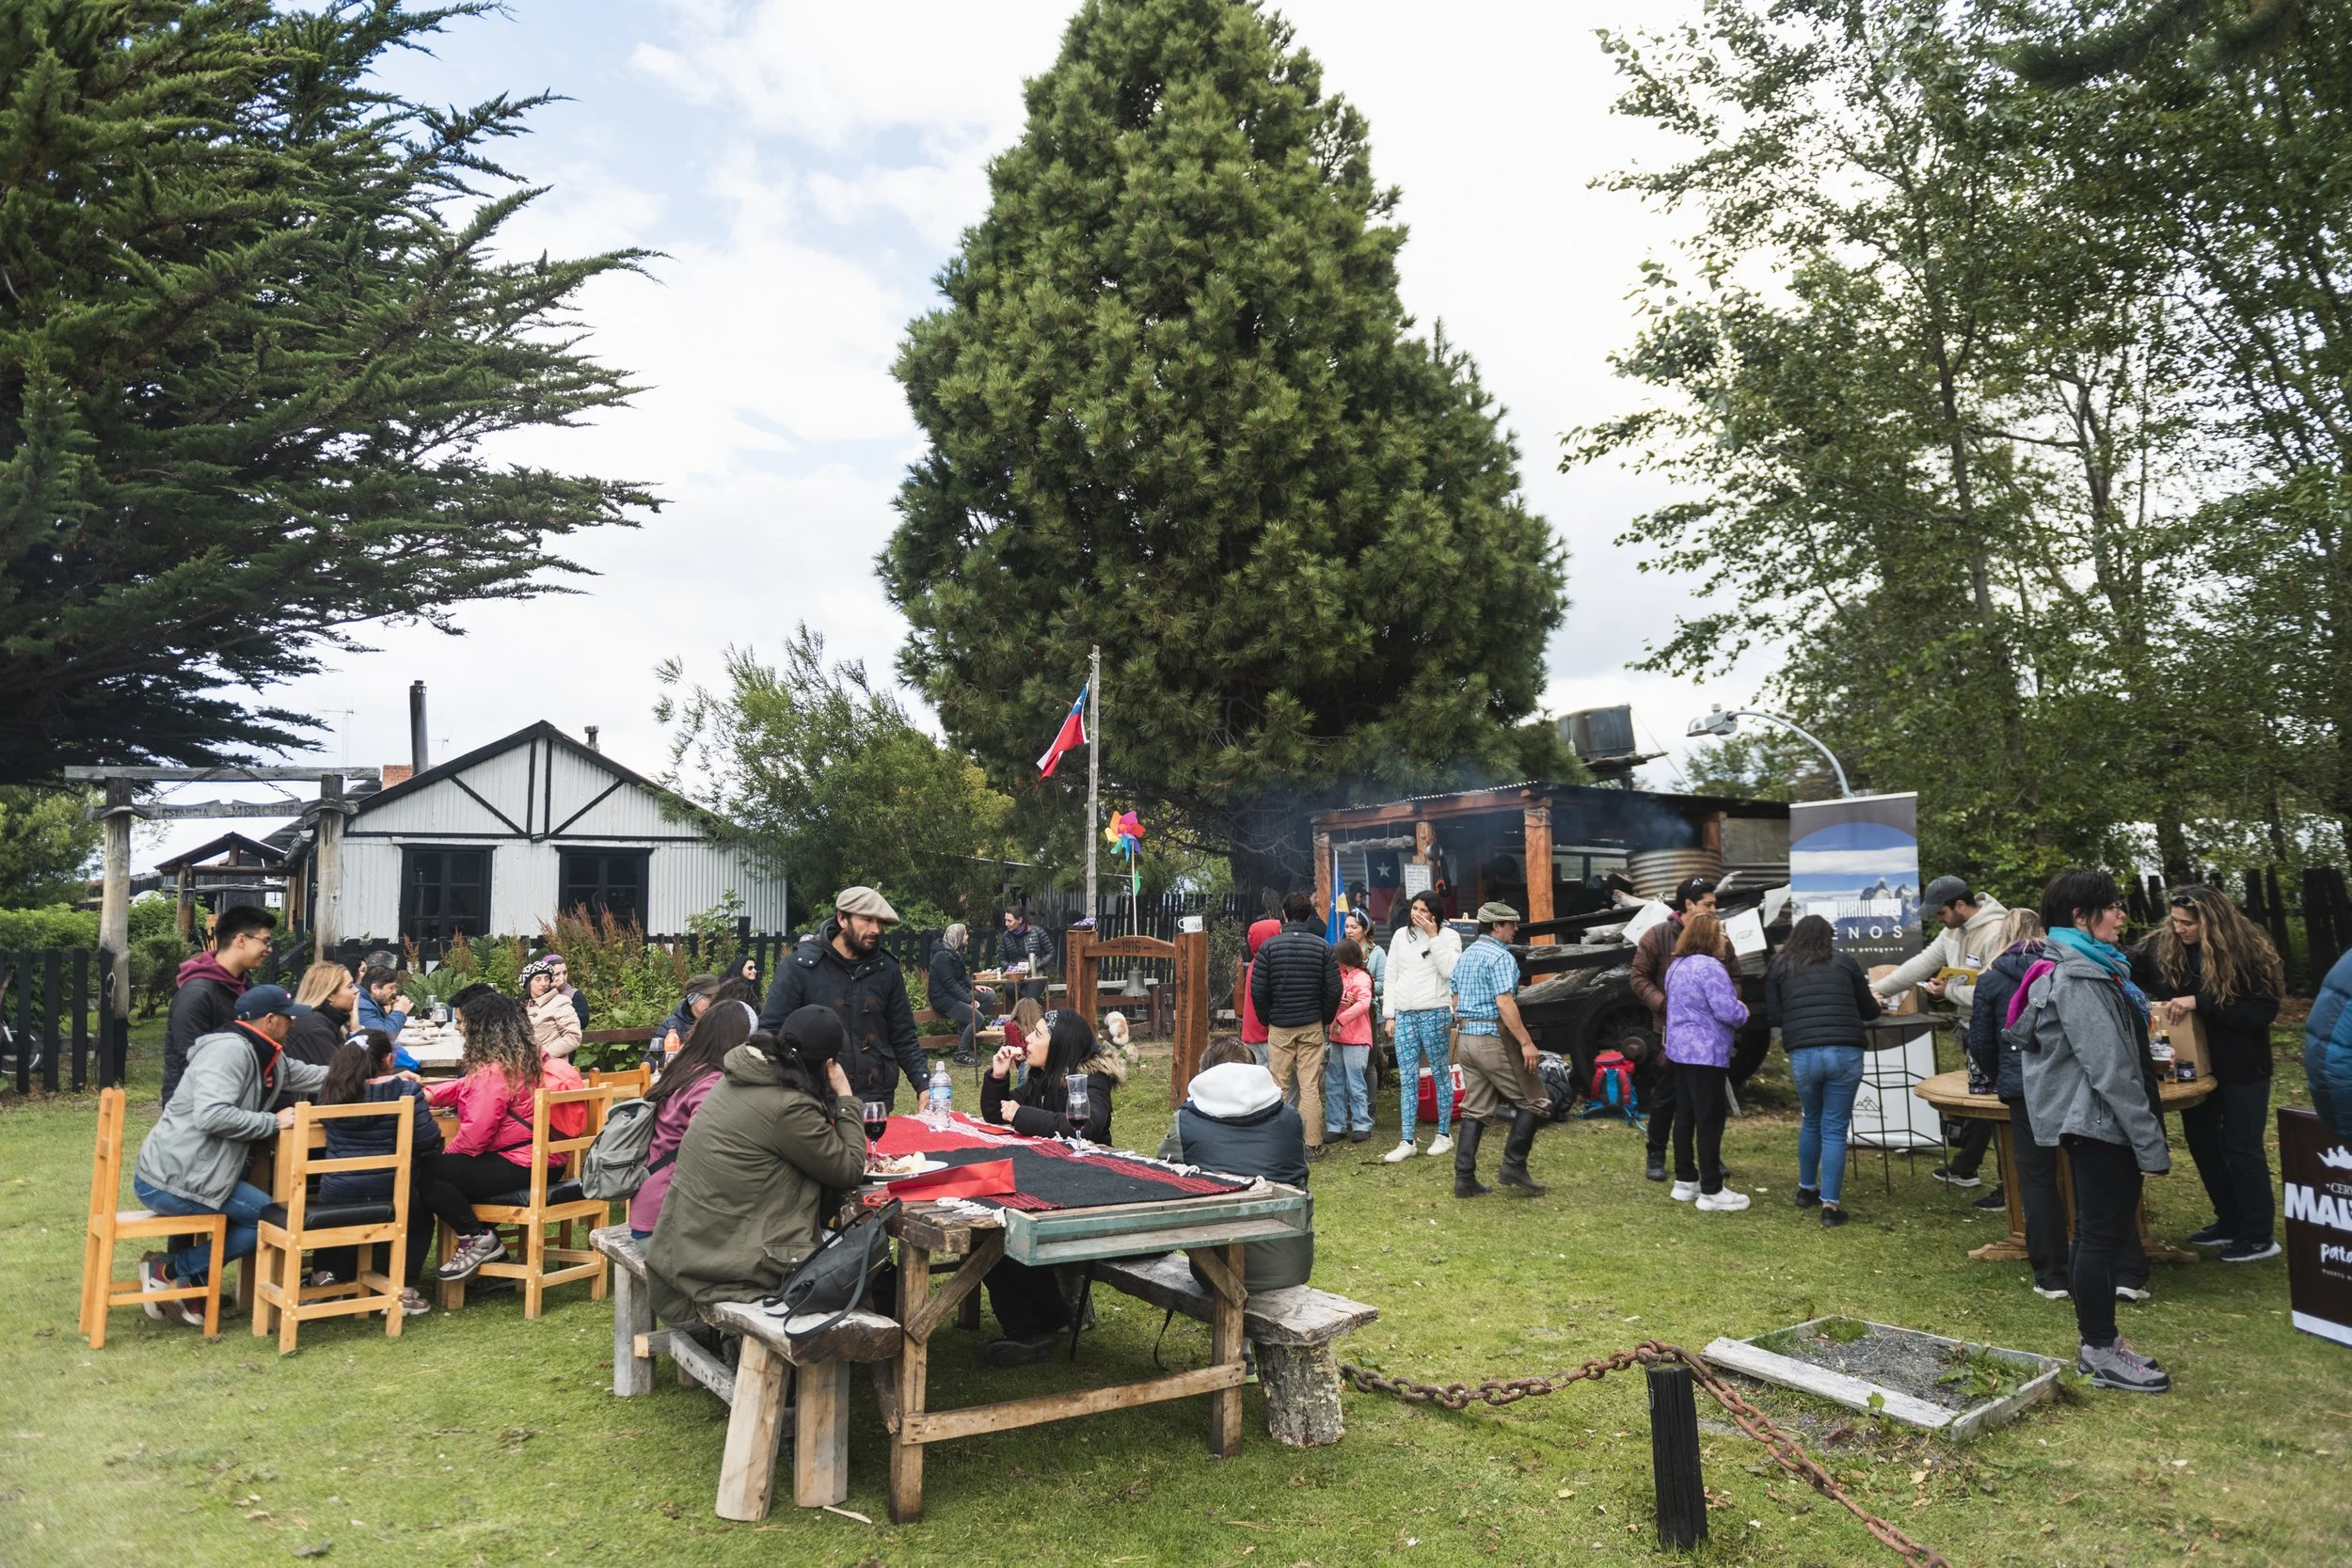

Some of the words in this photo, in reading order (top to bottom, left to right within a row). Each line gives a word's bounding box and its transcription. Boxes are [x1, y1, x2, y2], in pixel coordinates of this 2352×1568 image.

[162, 807, 209, 818] ESTANCIA
[1831, 925, 1903, 940] ÉNOS
[1121, 941, 1141, 954] 1916
[2330, 1182, 2352, 1196] CER
